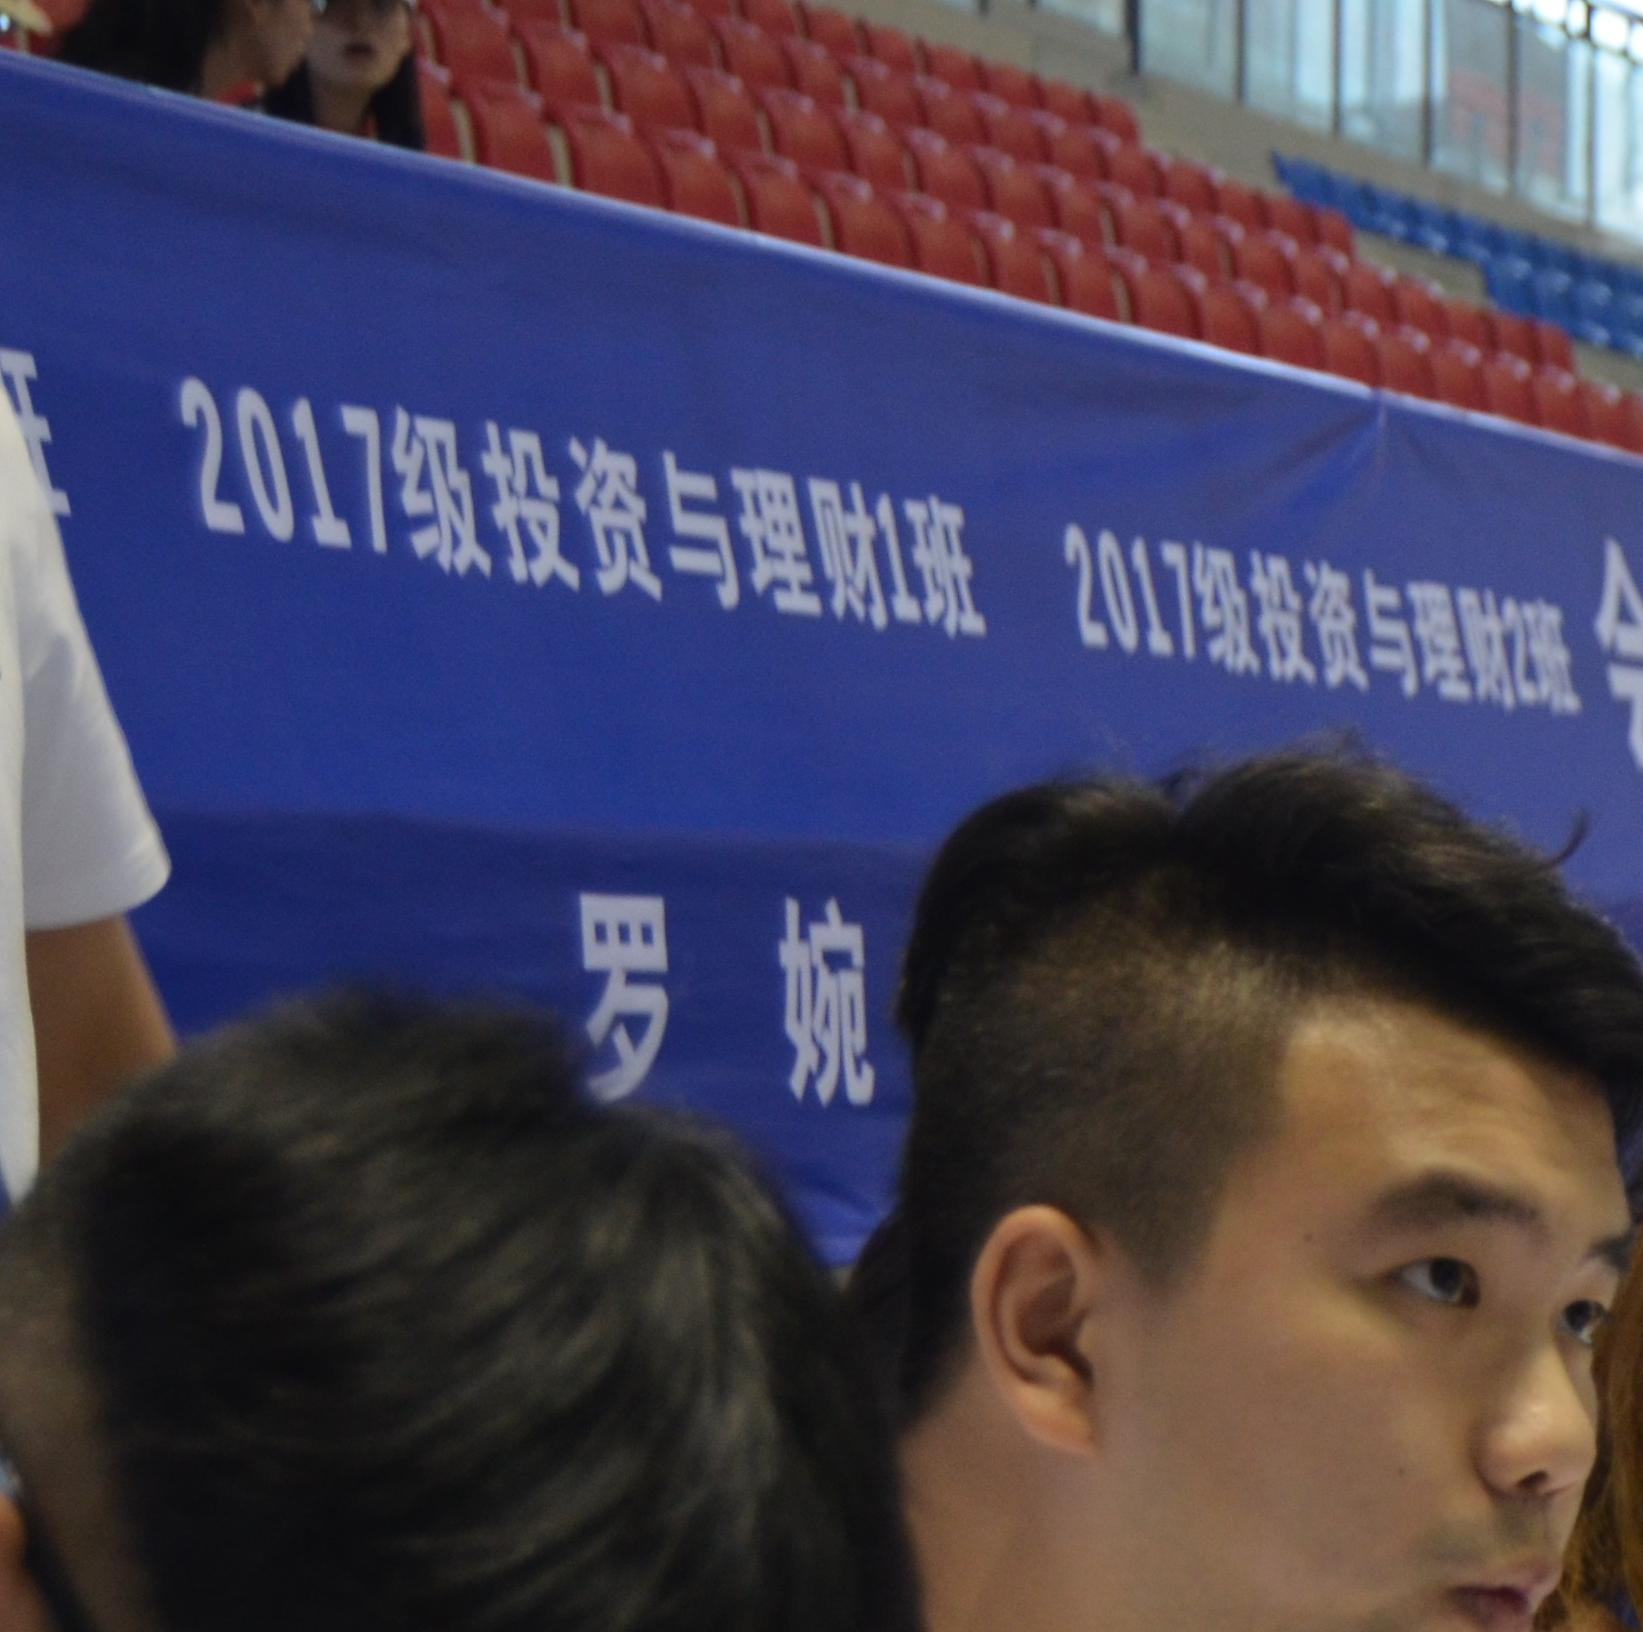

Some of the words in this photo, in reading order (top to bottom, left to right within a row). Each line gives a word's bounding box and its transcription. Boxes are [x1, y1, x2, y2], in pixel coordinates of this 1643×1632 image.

[178, 376, 986, 638] 2017级投资与理财1班
[1065, 523, 1581, 716] 2017级投资与理财2班
